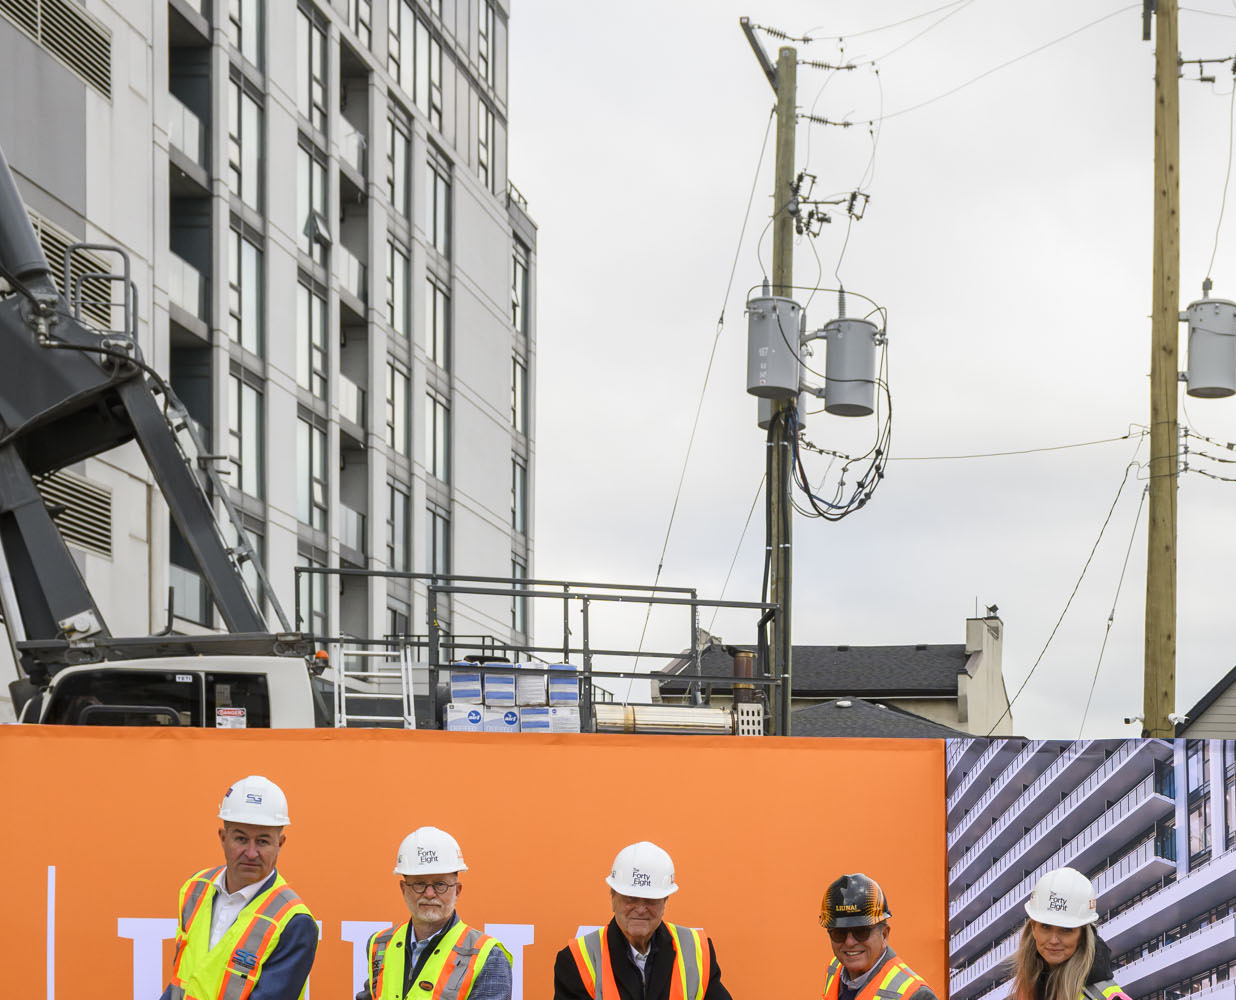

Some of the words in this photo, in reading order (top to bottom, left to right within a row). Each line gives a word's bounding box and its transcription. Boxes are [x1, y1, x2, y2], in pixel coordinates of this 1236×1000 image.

[632, 872, 650, 881] Forty
[633, 878, 651, 887] Eight
[1049, 895, 1067, 905] Forty
[1050, 902, 1067, 911] Eight
